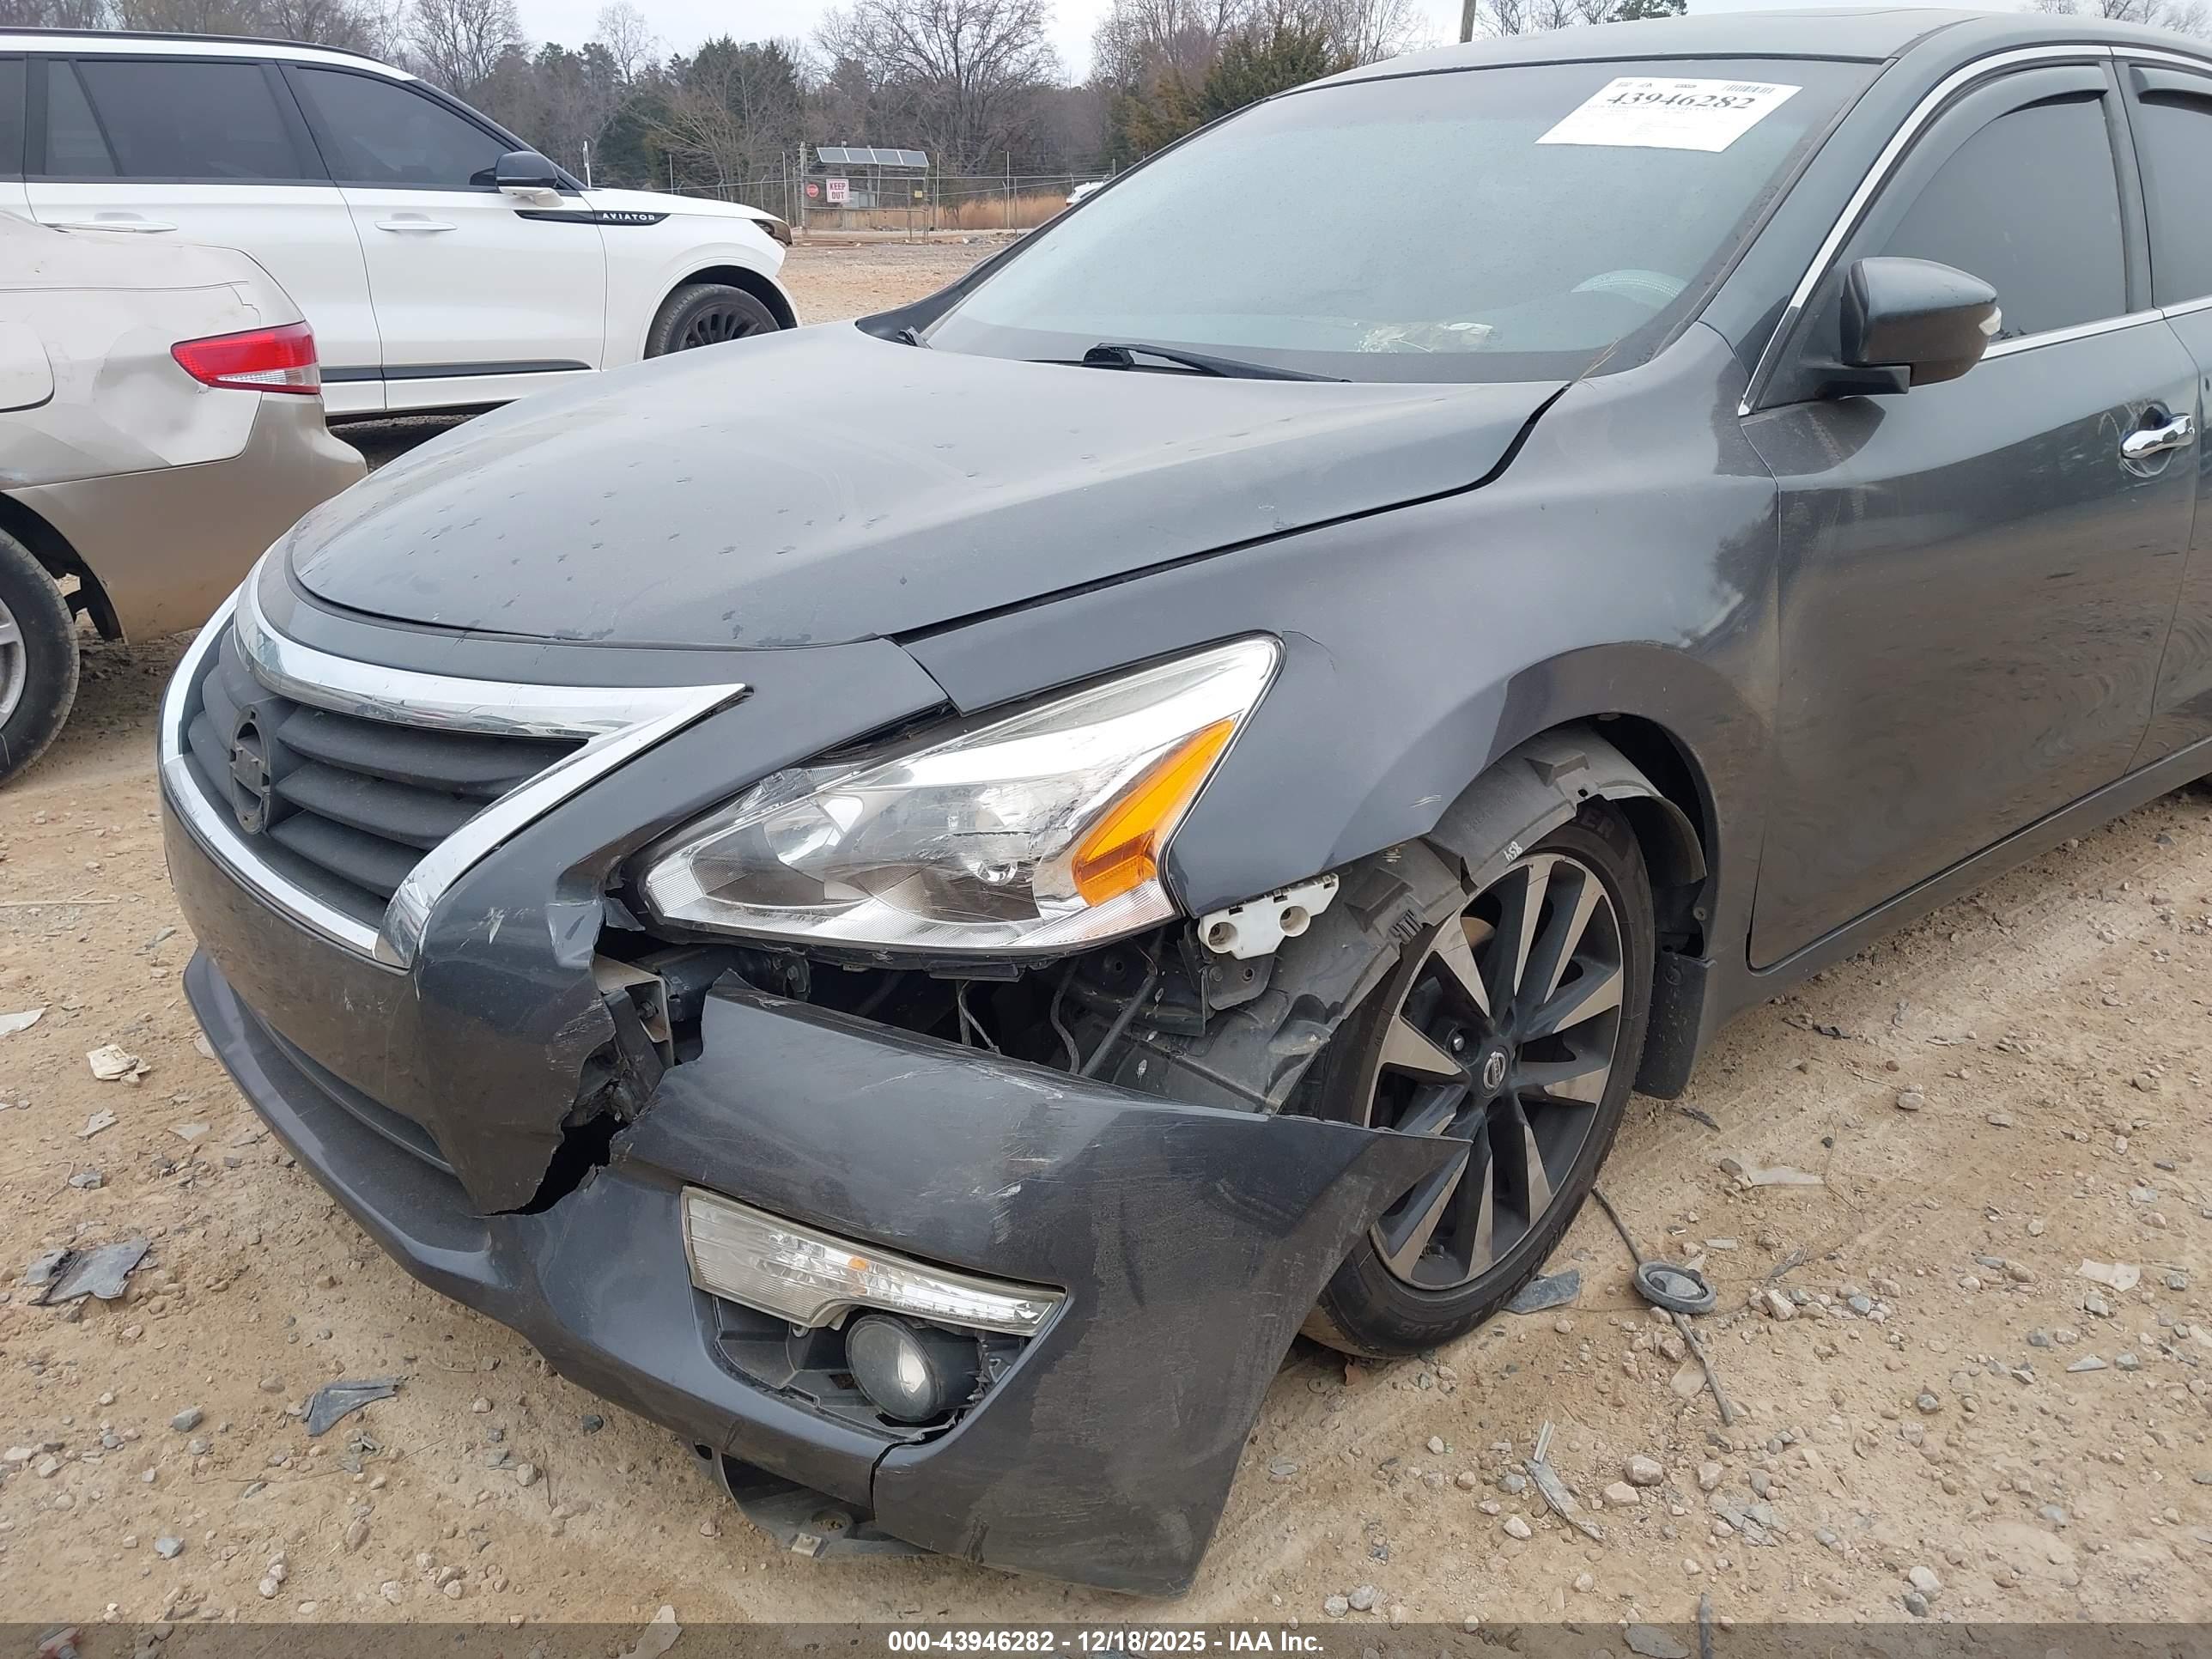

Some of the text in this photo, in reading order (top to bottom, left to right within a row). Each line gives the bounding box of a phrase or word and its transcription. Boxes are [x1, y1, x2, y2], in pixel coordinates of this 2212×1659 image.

[1607, 92, 1756, 109] 43946282
[830, 182, 846, 191] KEEP
[831, 191, 845, 200] OUT
[602, 213, 655, 222] AVIATOR
